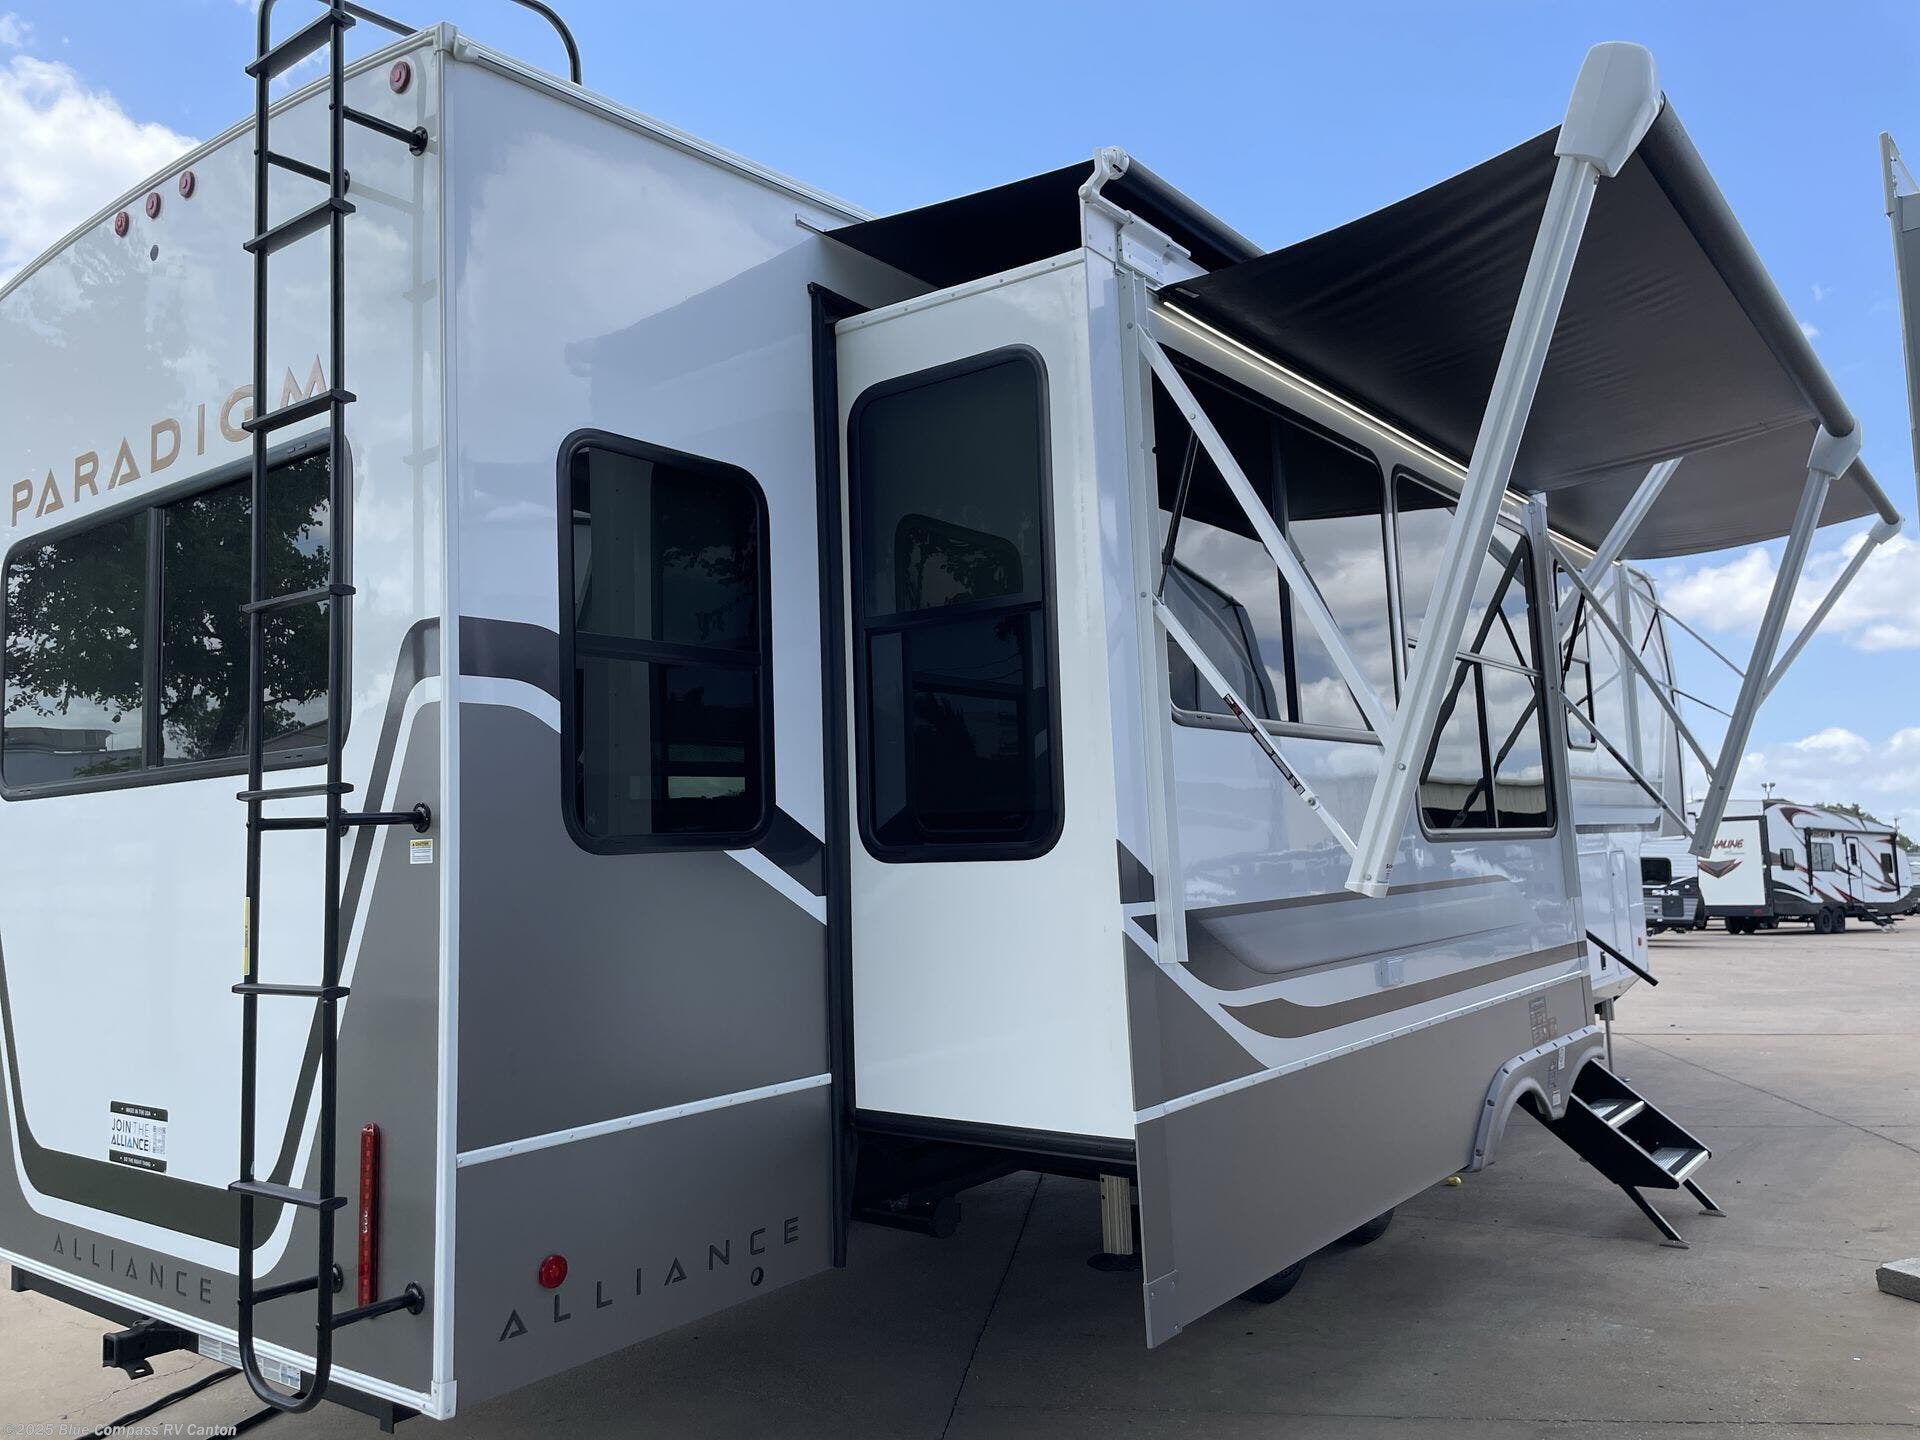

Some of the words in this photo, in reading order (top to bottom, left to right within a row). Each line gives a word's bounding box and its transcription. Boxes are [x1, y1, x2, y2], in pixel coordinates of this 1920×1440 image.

[11, 353, 329, 528] PARADIGM
[111, 1118, 132, 1134] JOIN
[132, 1121, 150, 1138] THE
[111, 1134, 149, 1152] ALLIANCE
[52, 1232, 213, 1304] ALLIANCE
[498, 1216, 801, 1343] ALLIANCE
